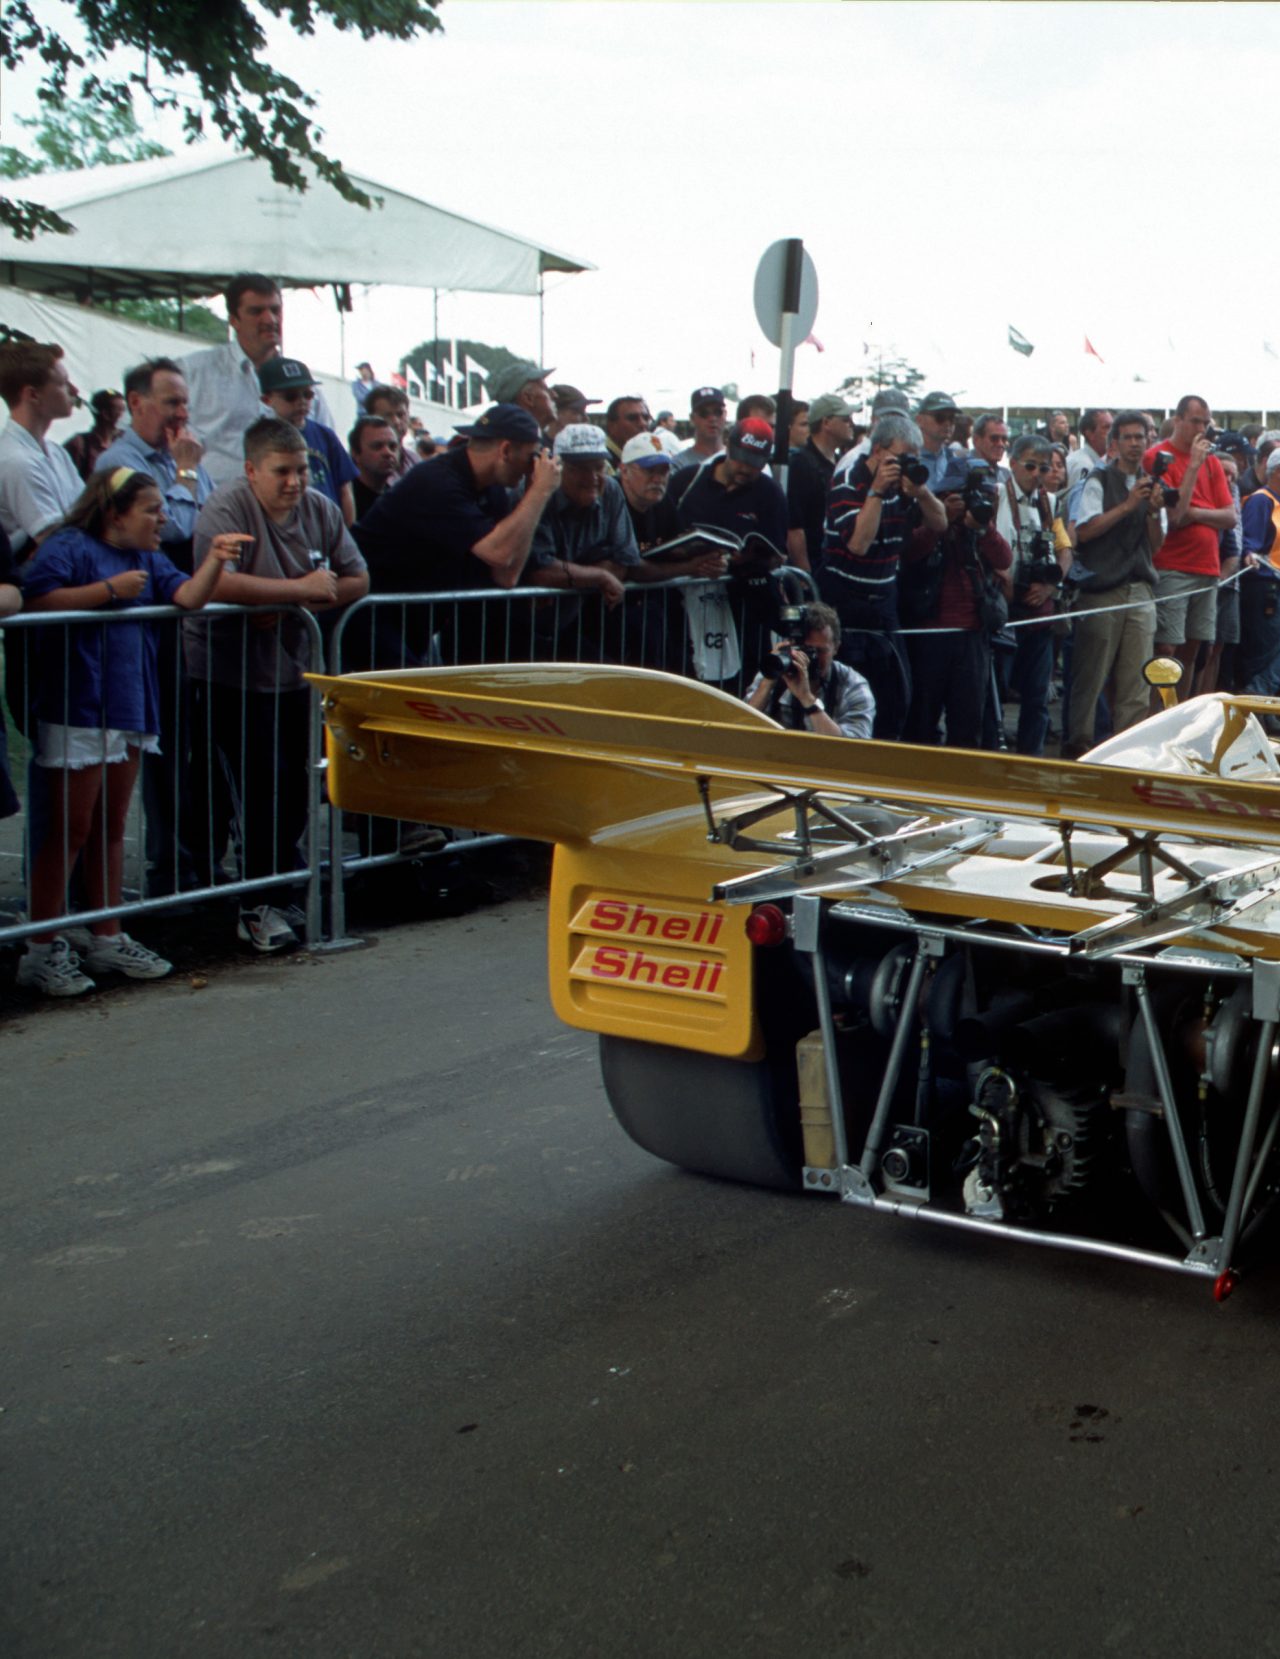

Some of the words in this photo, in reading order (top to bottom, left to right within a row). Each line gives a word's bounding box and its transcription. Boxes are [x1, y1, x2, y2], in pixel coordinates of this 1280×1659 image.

[741, 433, 768, 449] Bud
[404, 700, 566, 737] Shell
[590, 899, 724, 945] Shell
[591, 946, 723, 993] Shell
